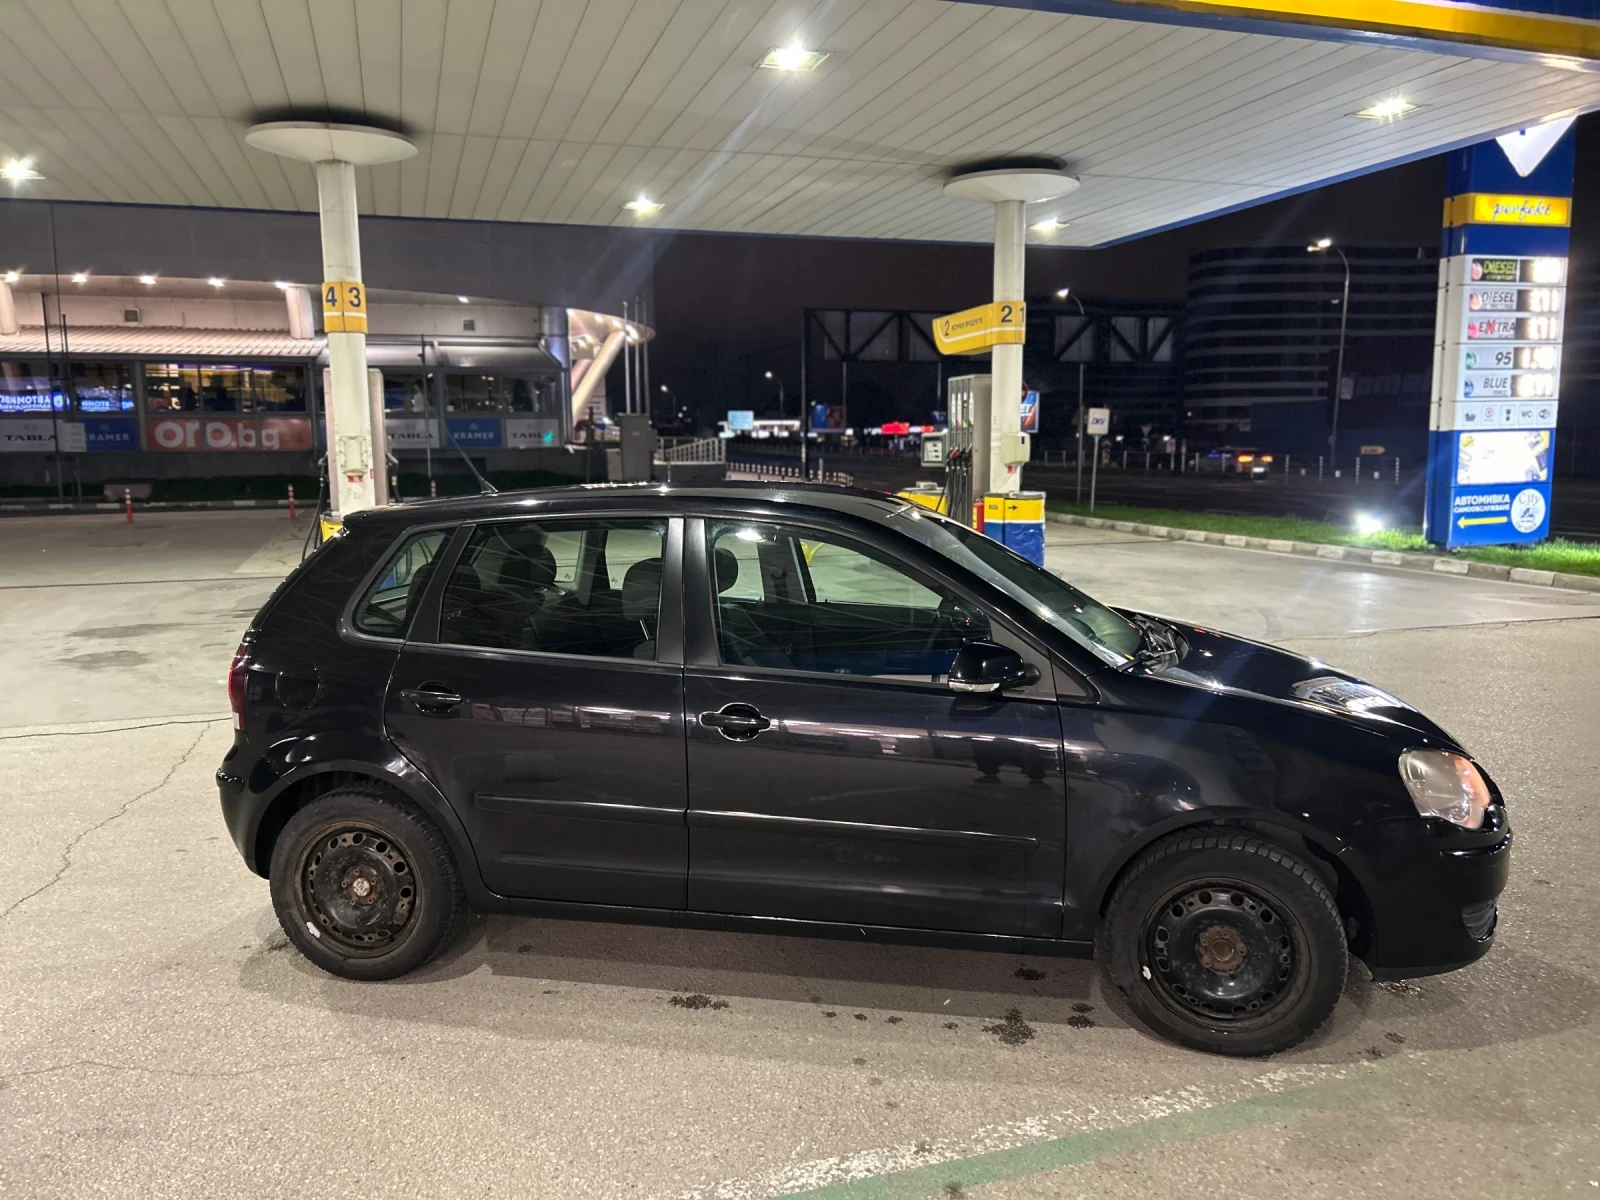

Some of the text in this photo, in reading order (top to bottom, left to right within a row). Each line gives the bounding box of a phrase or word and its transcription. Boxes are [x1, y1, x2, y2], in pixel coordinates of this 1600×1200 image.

[1491, 197, 1552, 222] perfekt
[1483, 260, 1517, 274] DIESEL
[325, 286, 362, 308] 4 3
[1481, 291, 1515, 303] DIESEL
[1001, 305, 1013, 323] 2
[944, 320, 950, 337] 2
[1495, 352, 1512, 366] 95
[1483, 377, 1509, 389] BLUE
[453, 432, 495, 440] KRAMER
[1454, 493, 1511, 506] АВТОМИВКА
[1518, 491, 1541, 506] City
